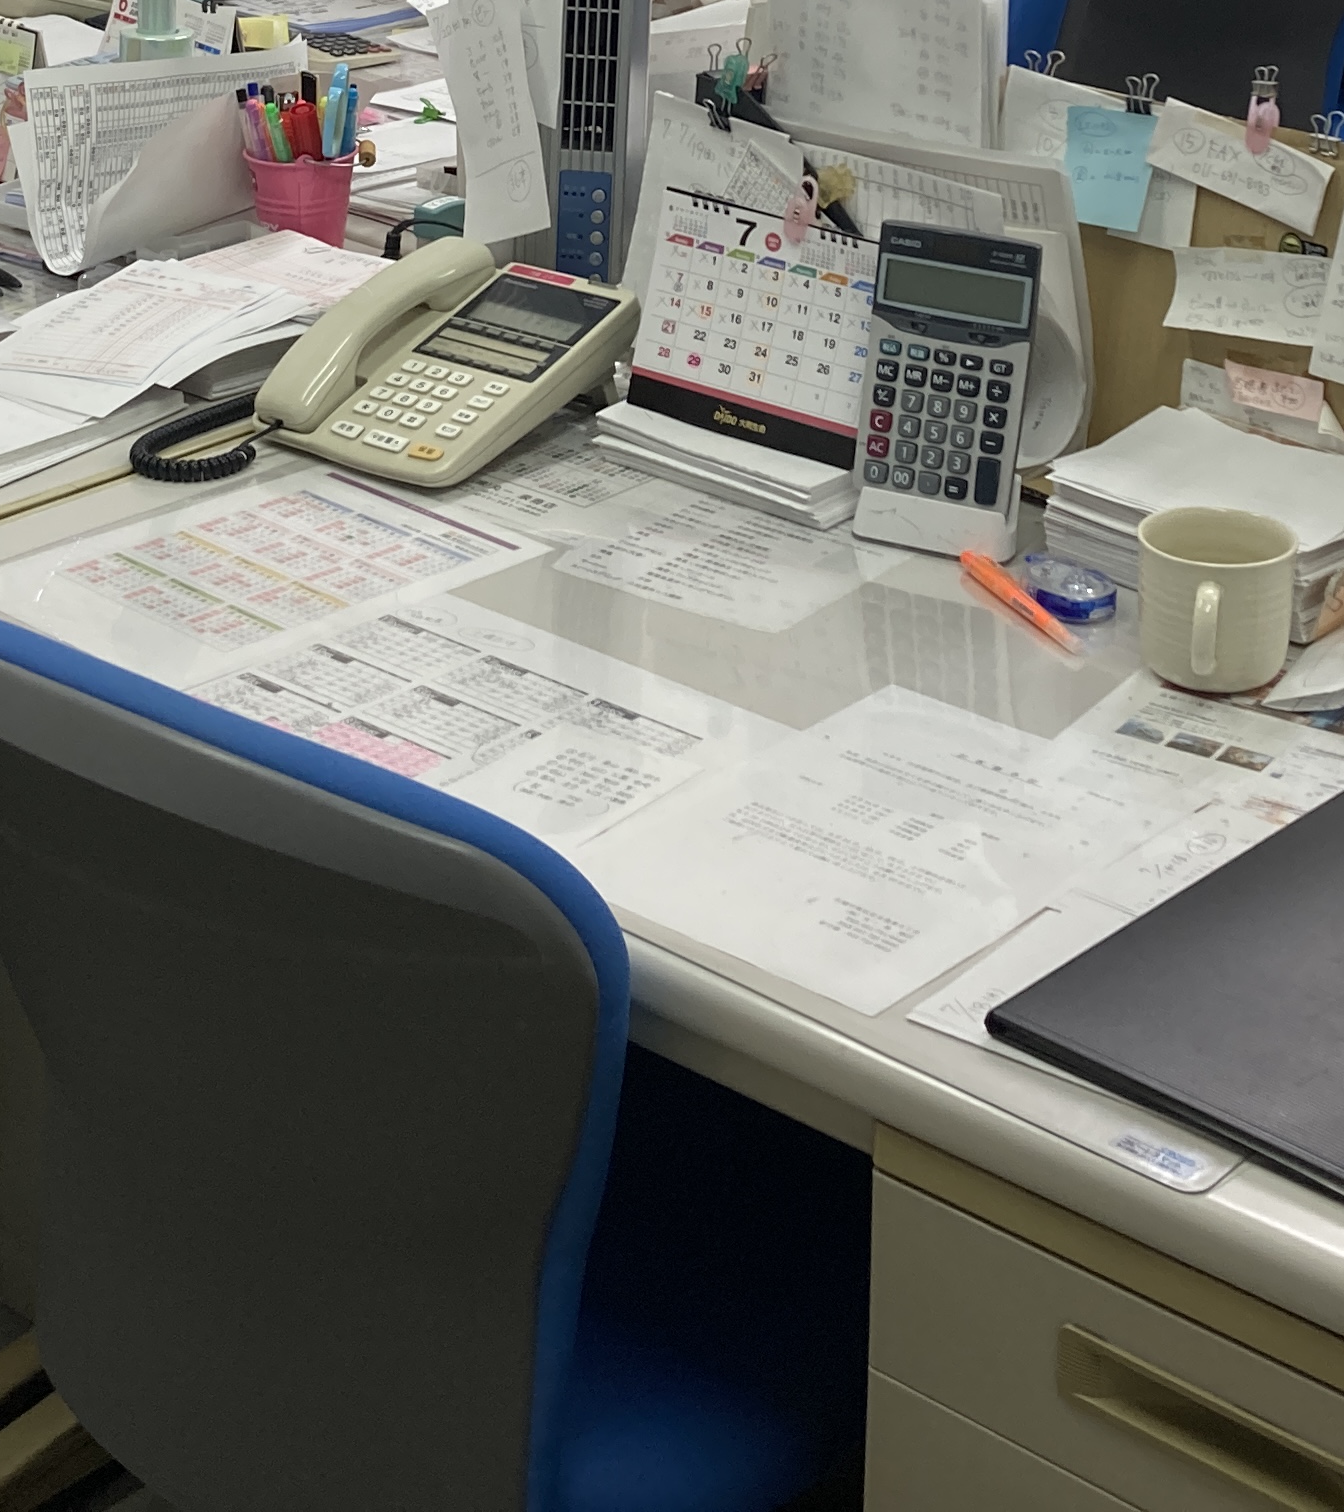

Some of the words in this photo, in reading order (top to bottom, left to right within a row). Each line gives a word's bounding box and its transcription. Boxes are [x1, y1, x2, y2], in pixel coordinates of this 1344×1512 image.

[1207, 140, 1242, 162] FAX
[736, 216, 758, 247] 7
[890, 236, 922, 248] CASIO
[712, 256, 716, 266] 1
[741, 263, 748, 273] 2
[772, 271, 779, 281] 3
[803, 279, 810, 289] 4
[834, 288, 842, 298] 5
[677, 273, 684, 284] 7
[706, 280, 714, 290] 8
[736, 288, 744, 298] 9
[766, 296, 778, 308] 10
[797, 304, 808, 316] 11
[828, 312, 841, 324] 12
[670, 297, 681, 308] 14
[700, 305, 712, 316] 15
[730, 313, 742, 324] 16
[761, 322, 774, 333] 17
[792, 330, 804, 341] 18
[824, 338, 836, 349] 19
[855, 346, 868, 358] 20
[662, 320, 676, 334] 21
[694, 330, 706, 342] 22
[724, 338, 737, 350] 23
[754, 346, 768, 358] 24
[786, 355, 798, 366] 25
[816, 363, 830, 374] 26
[848, 372, 862, 383] 27
[658, 346, 670, 358] 28
[688, 355, 700, 366] 29
[718, 363, 731, 374] 30
[748, 372, 762, 384] 31
[878, 364, 894, 376] MC
[993, 363, 1006, 372] GT
[906, 369, 922, 382] MR
[959, 379, 976, 390] M+
[908, 395, 916, 408] 7
[934, 400, 942, 414] 8
[960, 405, 968, 418] 9
[874, 415, 884, 428] C
[903, 421, 912, 434] 4
[930, 426, 938, 439] 5
[956, 432, 964, 444] 6
[869, 441, 884, 454] AC
[902, 446, 906, 458] 1
[926, 452, 934, 464] 2
[953, 457, 961, 470] 3
[870, 466, 878, 478] 0
[894, 472, 909, 484] 00
